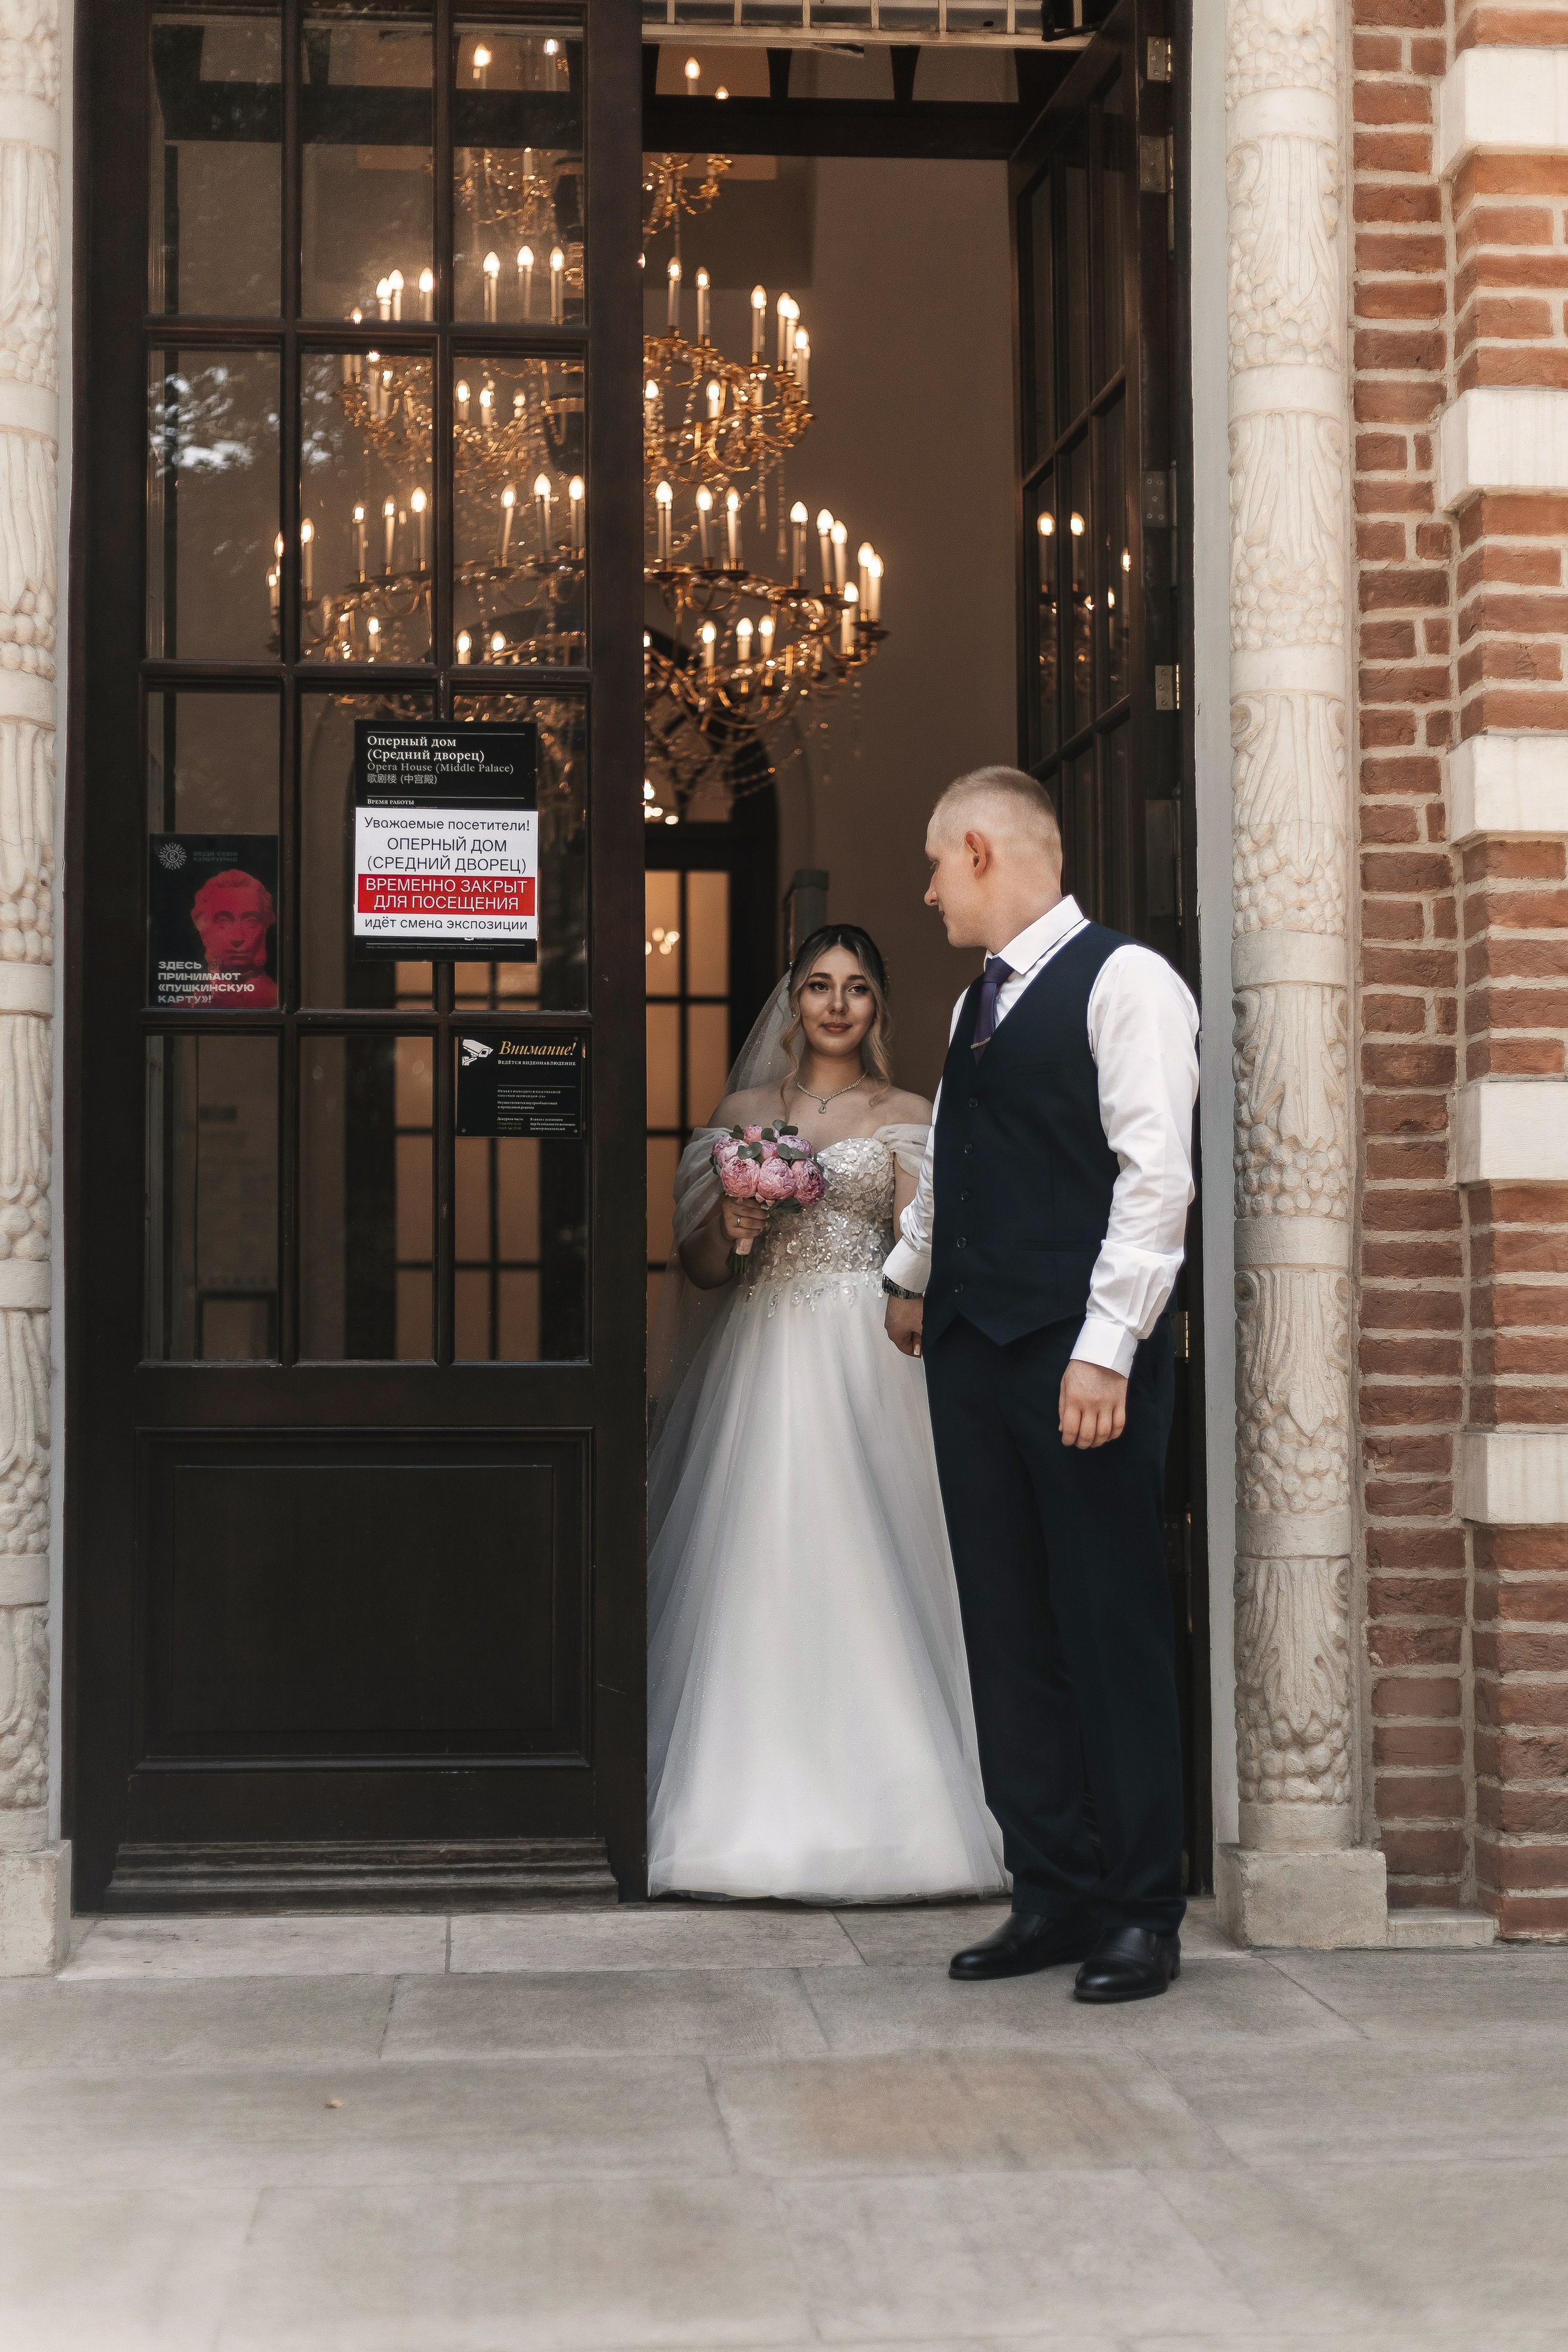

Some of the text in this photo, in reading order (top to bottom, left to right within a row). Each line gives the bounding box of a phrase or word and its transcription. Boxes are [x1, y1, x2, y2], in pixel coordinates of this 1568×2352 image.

[367, 736, 456, 748] Оперный дом
[368, 748, 484, 763] (Средний дворец)
[367, 763, 398, 773] Opera
[435, 763, 475, 774] (Middle
[478, 764, 514, 775] Palace)
[367, 774, 397, 784] 歌剧楼
[364, 816, 530, 832] Уважаемые посетители!
[387, 836, 507, 854] ОПЕРНЫЙ ДОМ
[368, 855, 526, 874] (СРЕДНИЙ ДВОРЕЦ)
[366, 878, 527, 894] ВРЕМЕННО ЗАКРЫТ
[374, 895, 519, 911] ДЛЯ ПОСЕЩЕНИЯ
[365, 916, 527, 932] идёт смена экспозиции
[158, 962, 202, 970] ЗДЕСЬ
[158, 984, 255, 992] «ПУШКИНСКУЮ
[157, 995, 212, 1004] КАРТУ»!
[498, 1041, 576, 1056] Внимание!
